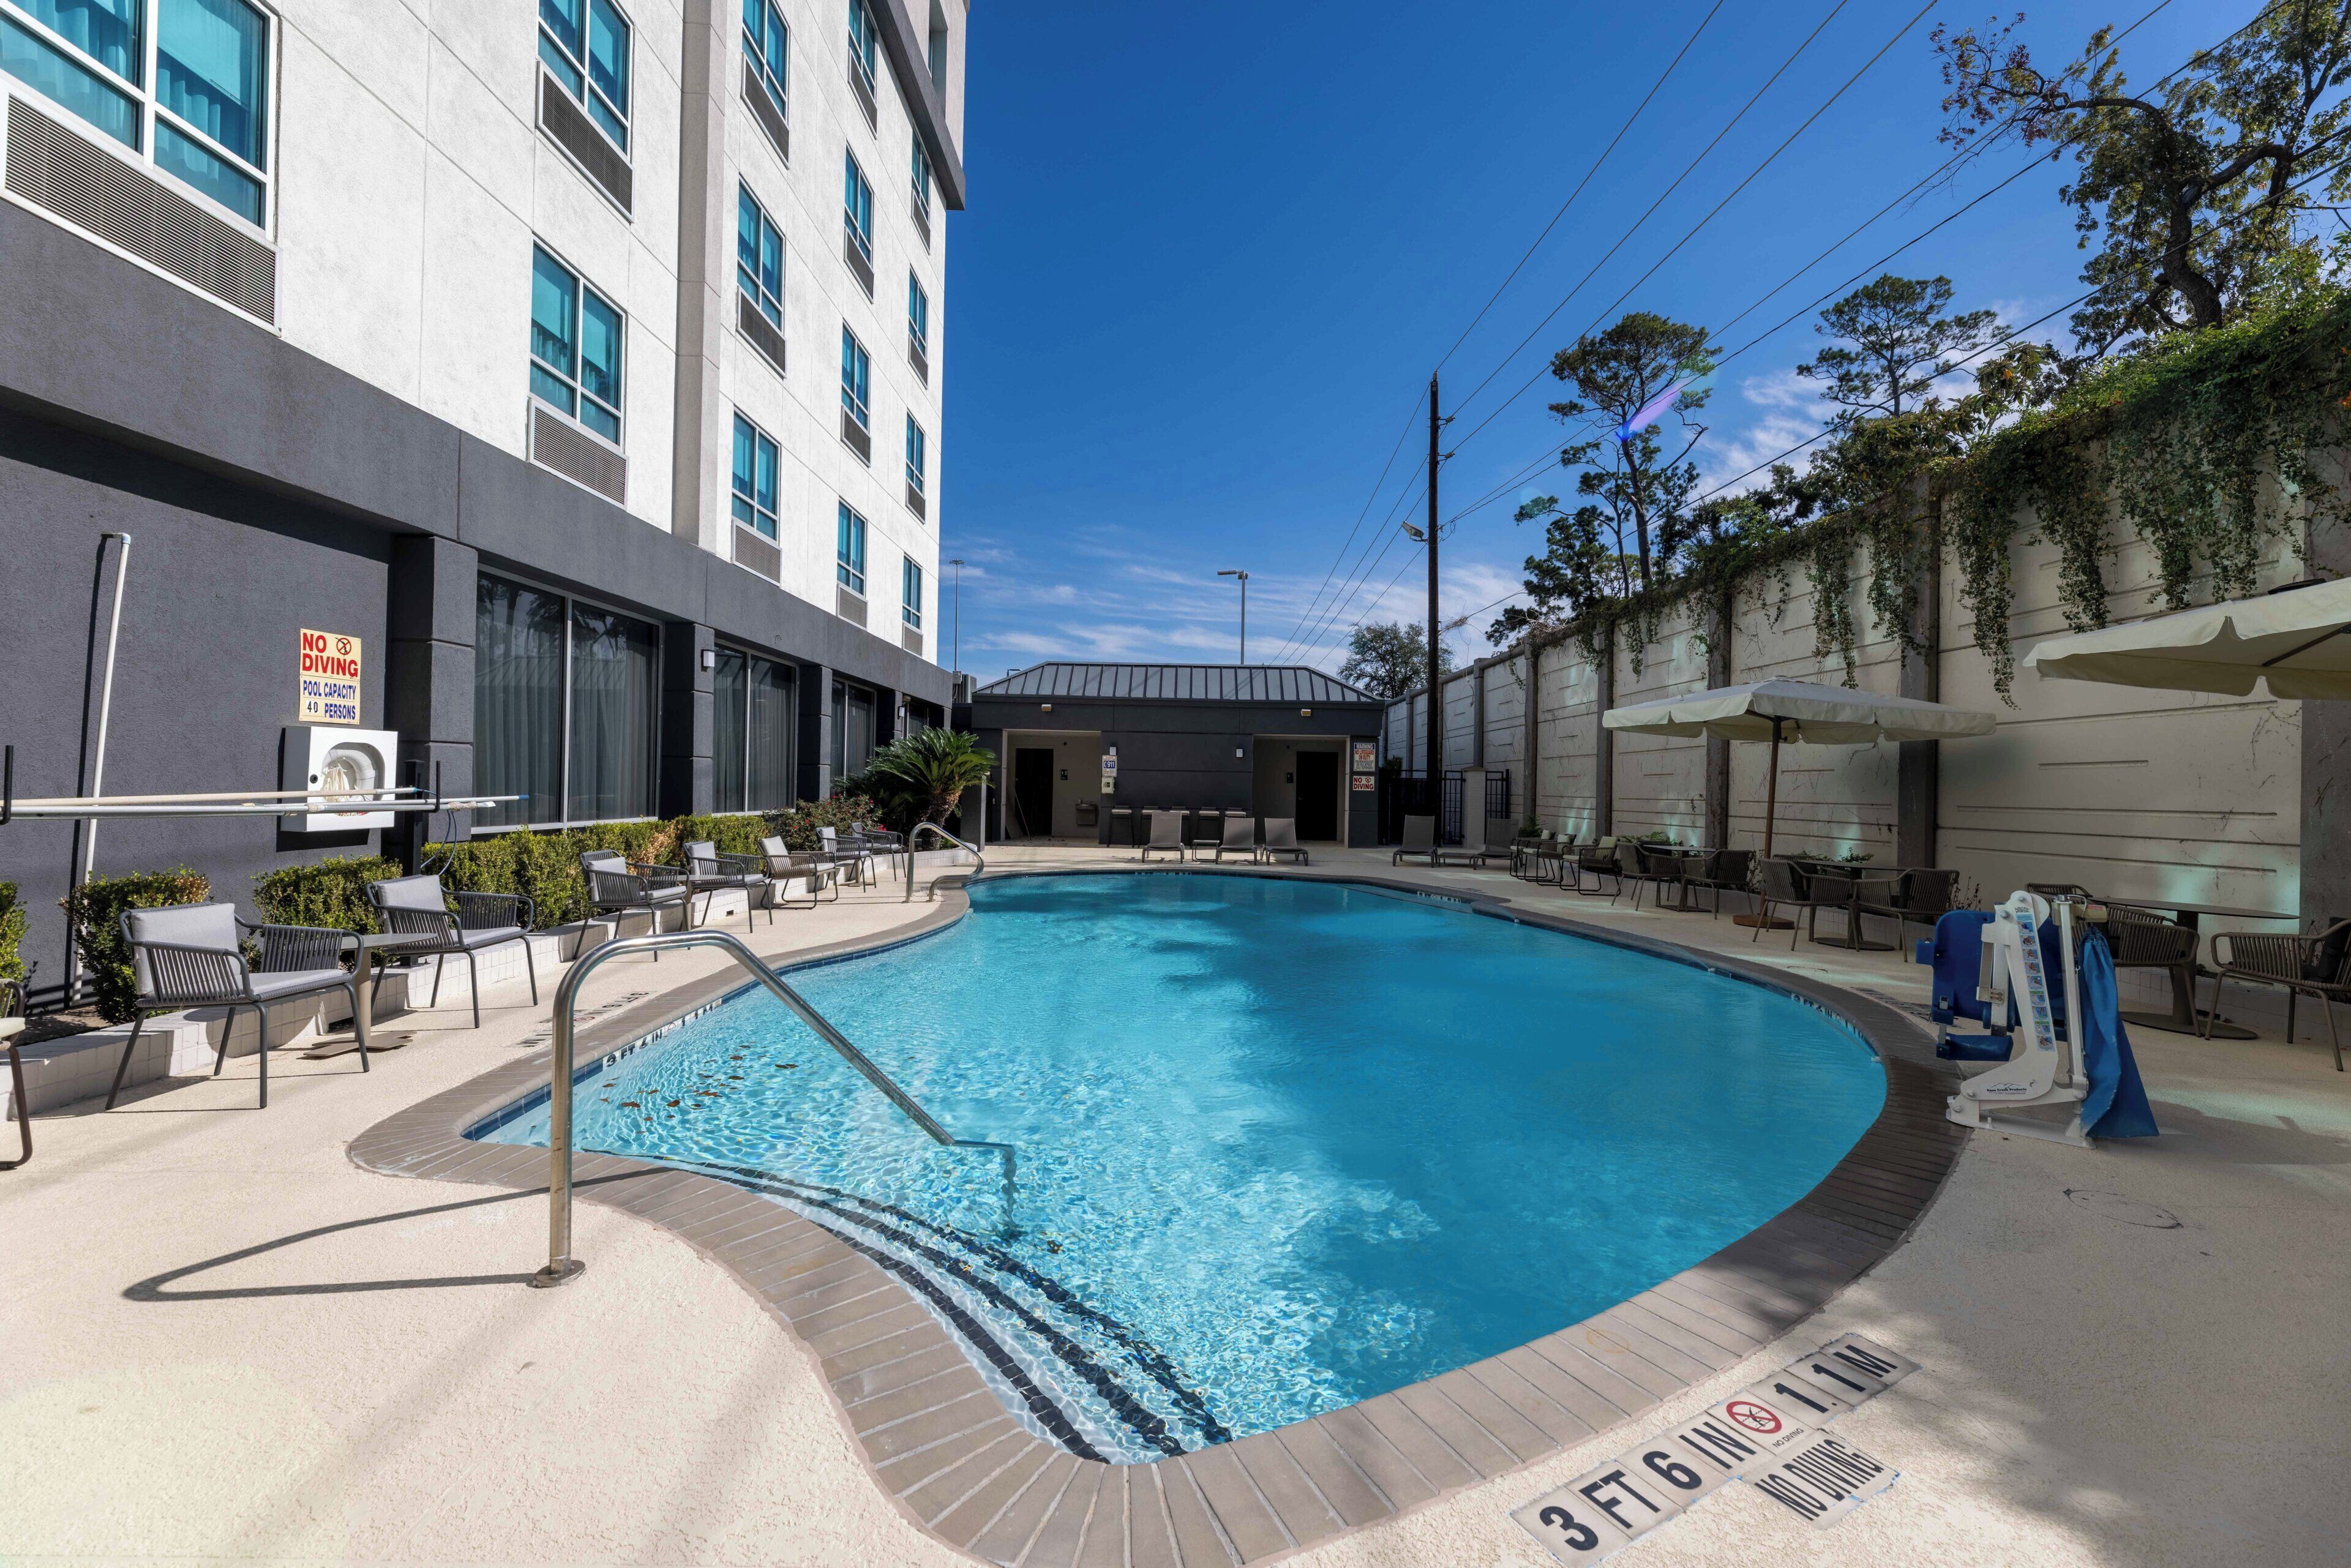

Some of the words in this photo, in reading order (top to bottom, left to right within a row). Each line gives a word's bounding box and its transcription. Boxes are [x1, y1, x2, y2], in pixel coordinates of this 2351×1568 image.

[302, 632, 327, 653] NO
[302, 653, 358, 678] DIVING
[303, 680, 322, 697] POOL
[324, 682, 356, 700] CAPACITY
[307, 701, 318, 713] 40
[324, 703, 356, 720] PERSONS
[1825, 1008, 1832, 1018] IN
[621, 1043, 636, 1060] FT
[651, 1029, 662, 1043] IN
[1539, 1505, 1599, 1551] 3
[1578, 1469, 1662, 1529] FT
[1642, 1450, 1703, 1490] 6
[1678, 1422, 1757, 1470] IN
[1833, 1344, 1899, 1379] M
[1772, 1439, 1785, 1448] NO
[1782, 1428, 1804, 1442] DIVING
[1782, 1439, 1885, 1503] DIVING
[1755, 1473, 1829, 1522] NO
